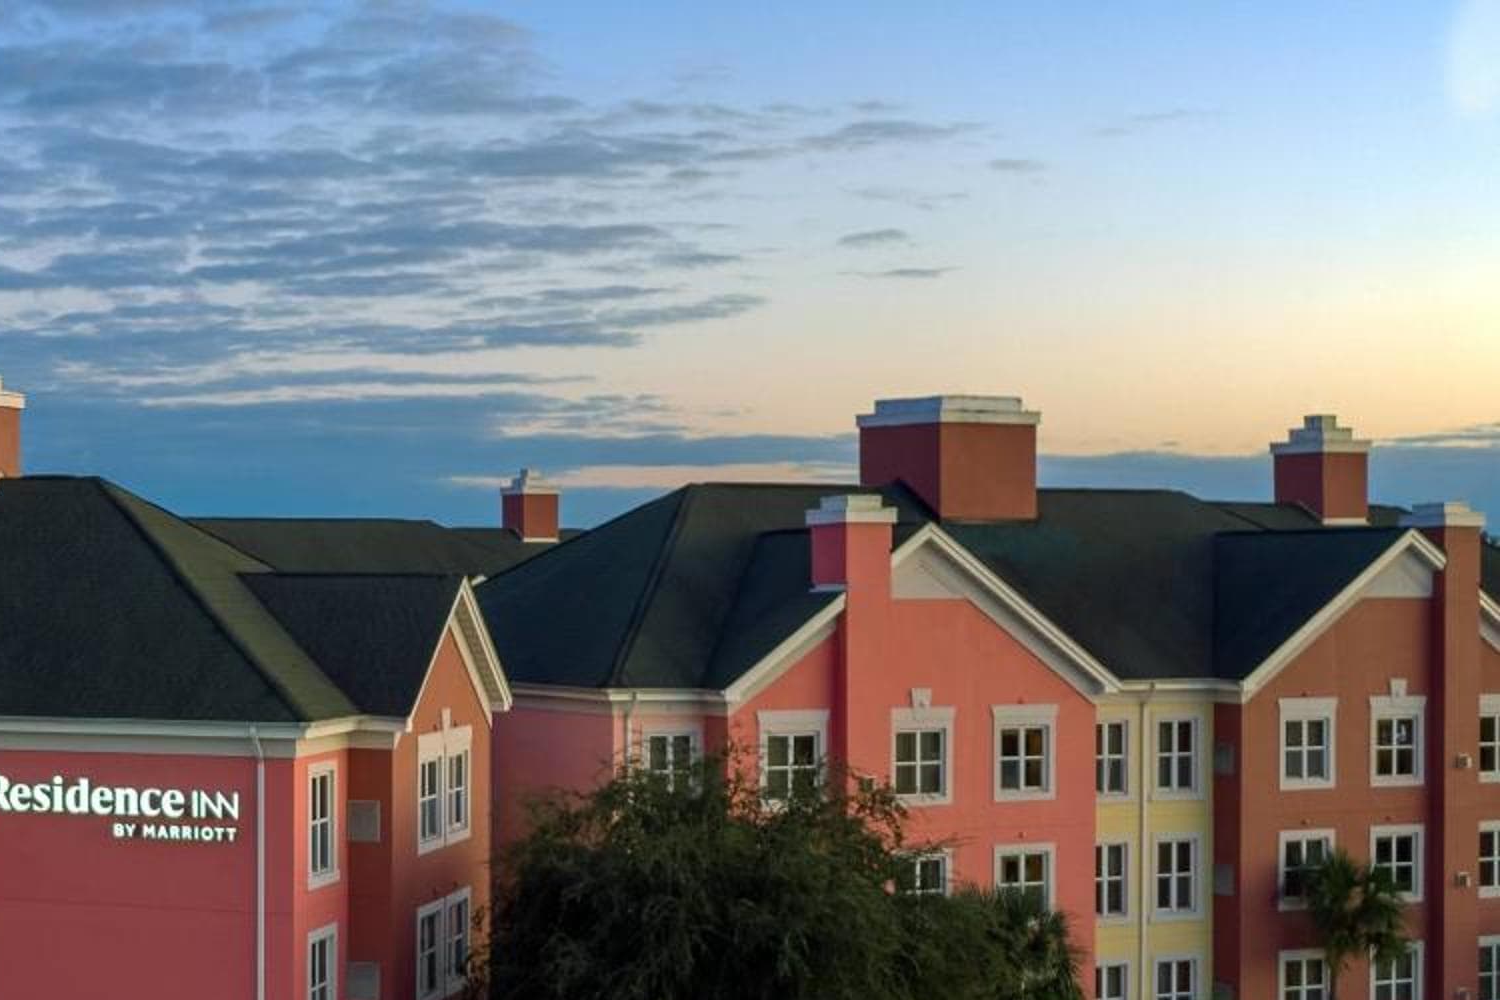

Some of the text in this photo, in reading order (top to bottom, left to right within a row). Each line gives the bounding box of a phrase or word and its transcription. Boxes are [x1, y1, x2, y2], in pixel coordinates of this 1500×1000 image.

[191, 789, 239, 821] INN
[112, 822, 237, 842] BY MARRIOTT
